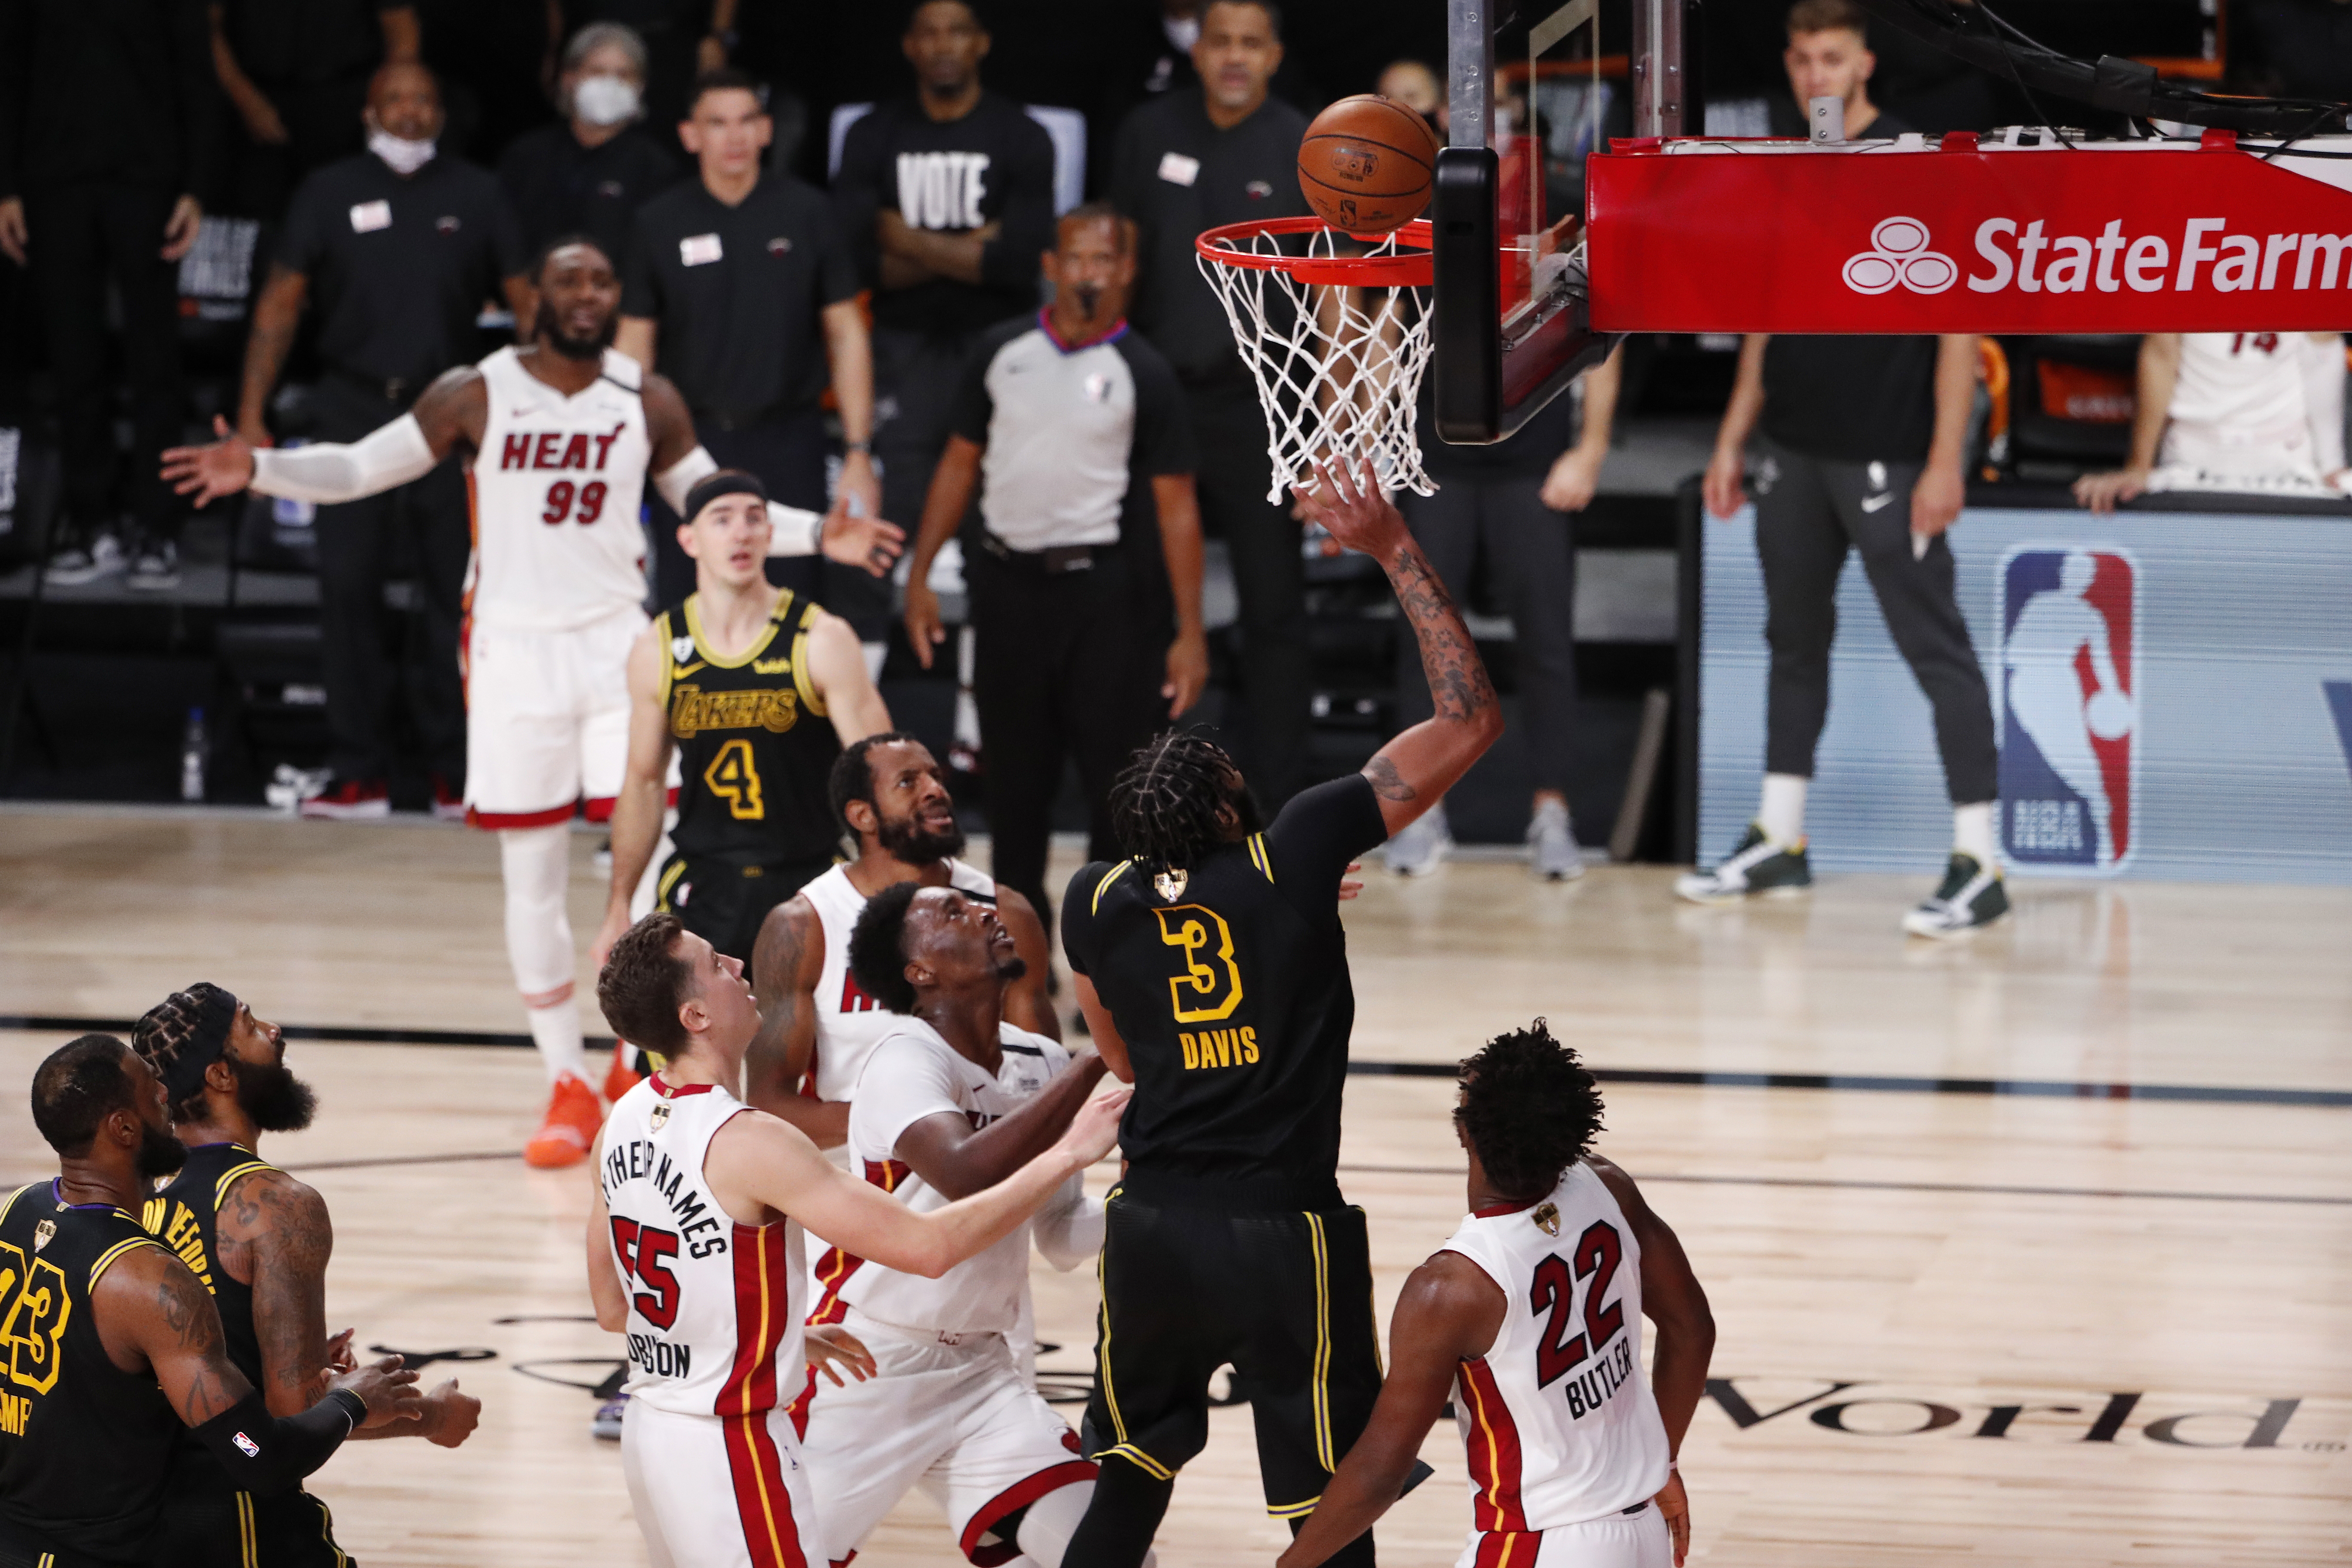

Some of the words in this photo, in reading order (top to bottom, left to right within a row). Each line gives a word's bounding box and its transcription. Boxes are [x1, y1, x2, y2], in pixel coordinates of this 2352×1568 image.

[896, 151, 991, 230] VOTE
[501, 421, 625, 471] HEAT
[542, 481, 607, 525] 99
[704, 738, 765, 821] 4
[2013, 799, 2083, 850] NBA
[1152, 903, 1243, 1024] 3
[1178, 1026, 1260, 1070] DAVIS
[653, 1152, 727, 1260] NAMES
[609, 1215, 680, 1332] 55
[1530, 1219, 1624, 1391] 22
[0, 1240, 72, 1396] 23
[1565, 1336, 1633, 1420] BUTLER
